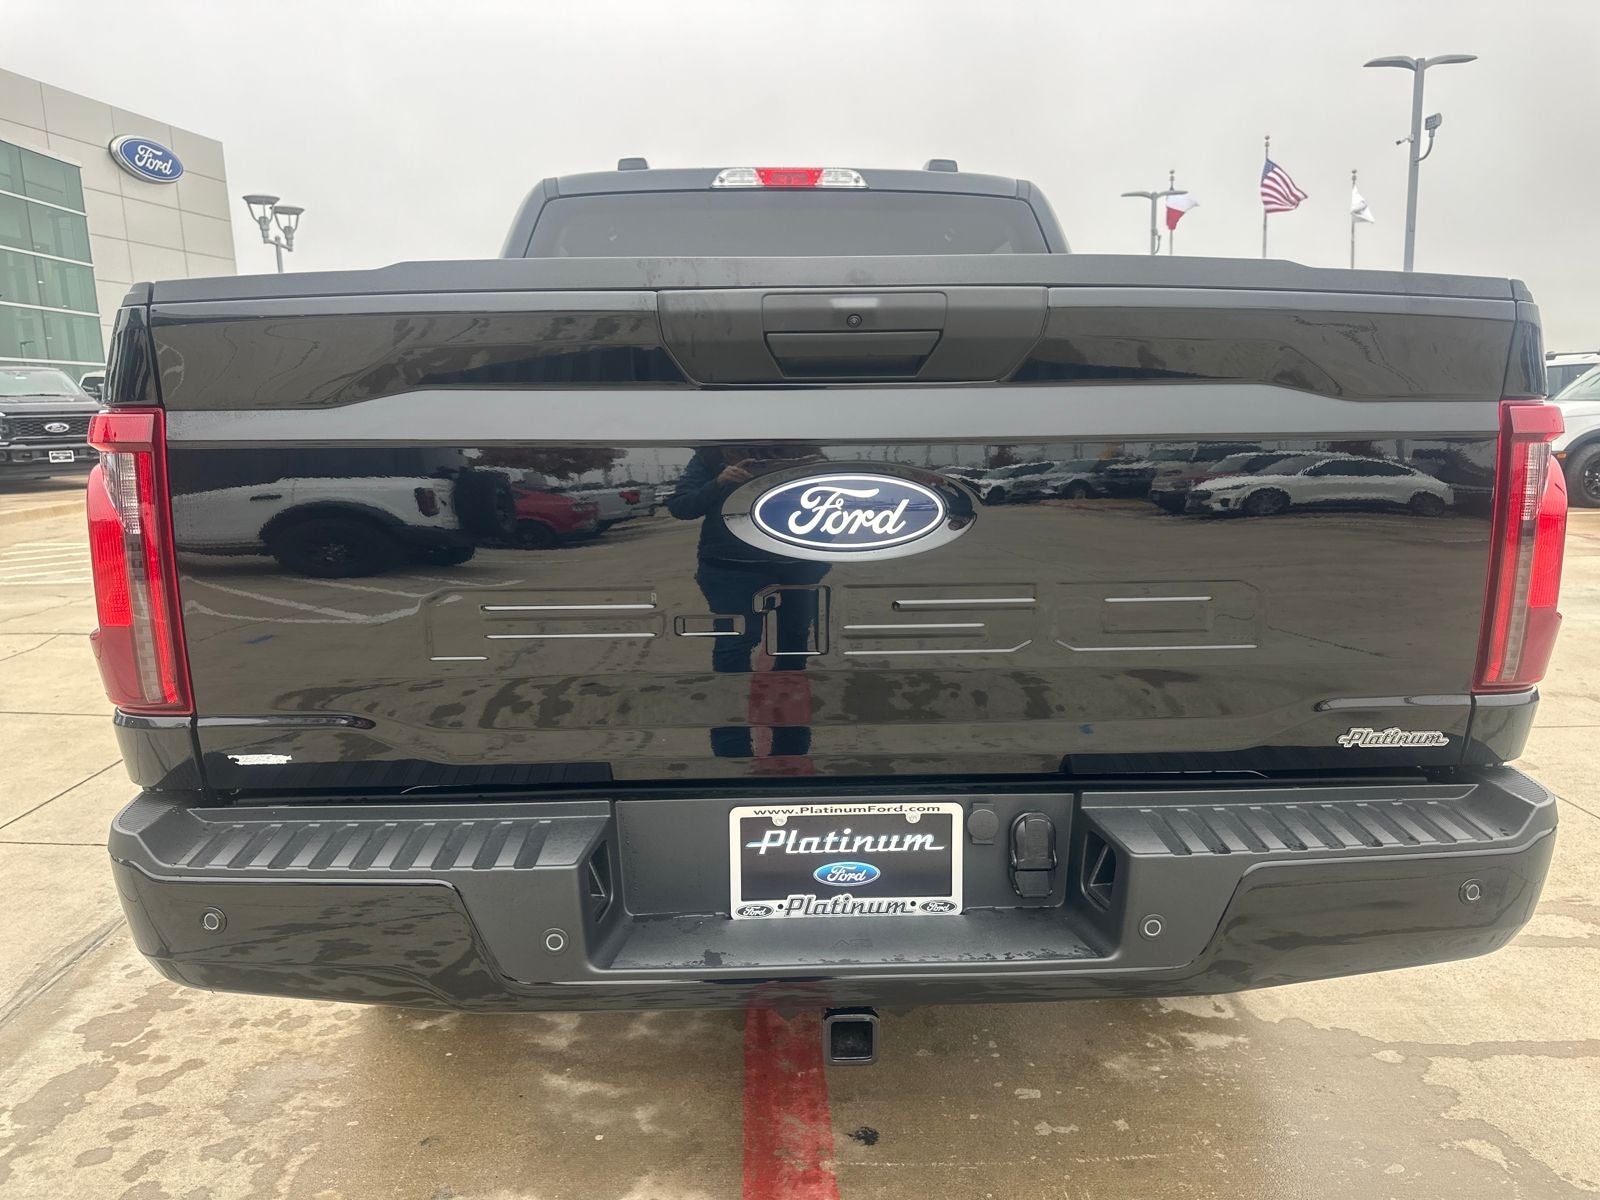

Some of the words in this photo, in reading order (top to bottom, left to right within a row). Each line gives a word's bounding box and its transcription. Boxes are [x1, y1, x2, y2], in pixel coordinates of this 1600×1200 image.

[134, 144, 173, 175] Ford
[788, 486, 910, 535] Ford
[1338, 727, 1449, 748] Platinum
[753, 805, 941, 816] www.PlatinumFord.com
[745, 827, 946, 855] Platinum
[826, 865, 867, 882] Ford
[742, 907, 767, 917] Ford
[778, 896, 914, 916] Platinum
[926, 902, 950, 913] Ford
